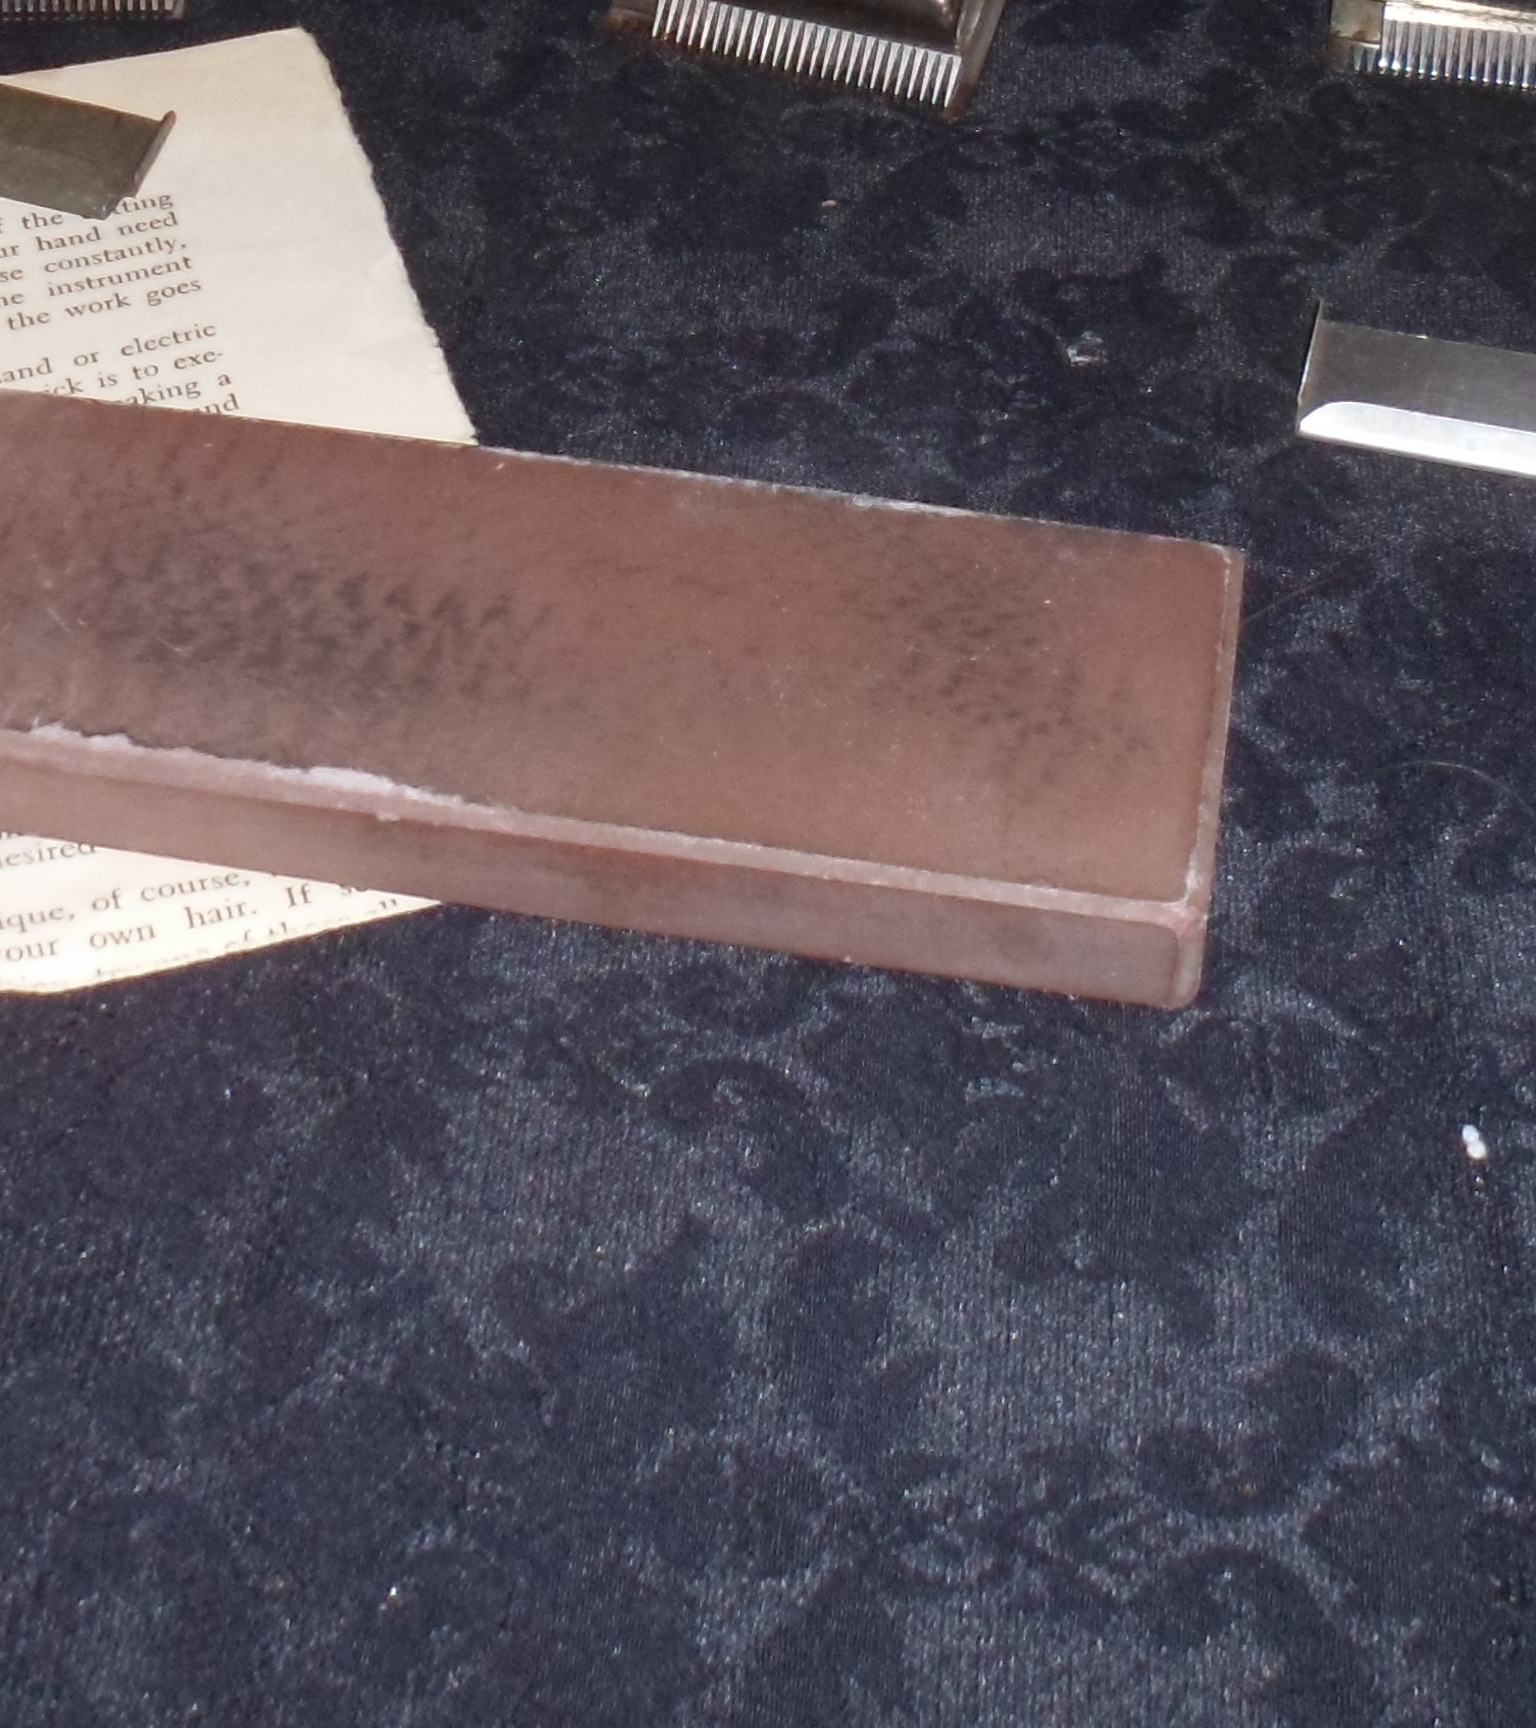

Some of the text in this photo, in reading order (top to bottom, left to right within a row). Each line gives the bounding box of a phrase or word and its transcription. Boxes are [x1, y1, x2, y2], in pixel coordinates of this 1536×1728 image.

[20, 209, 64, 232] the
[36, 227, 102, 253] hand
[117, 211, 180, 237] need
[43, 235, 188, 274] constantly,
[47, 254, 193, 298] instrument
[6, 310, 51, 332] the
[64, 291, 132, 320] work
[146, 277, 204, 308] goes
[73, 350, 101, 368] or
[120, 322, 218, 357] electric
[98, 371, 118, 389] is
[132, 361, 161, 382] to
[217, 370, 232, 389] a
[91, 872, 252, 914] of course,
[89, 923, 157, 951] own
[183, 900, 259, 931] hair.
[285, 884, 314, 908] If
